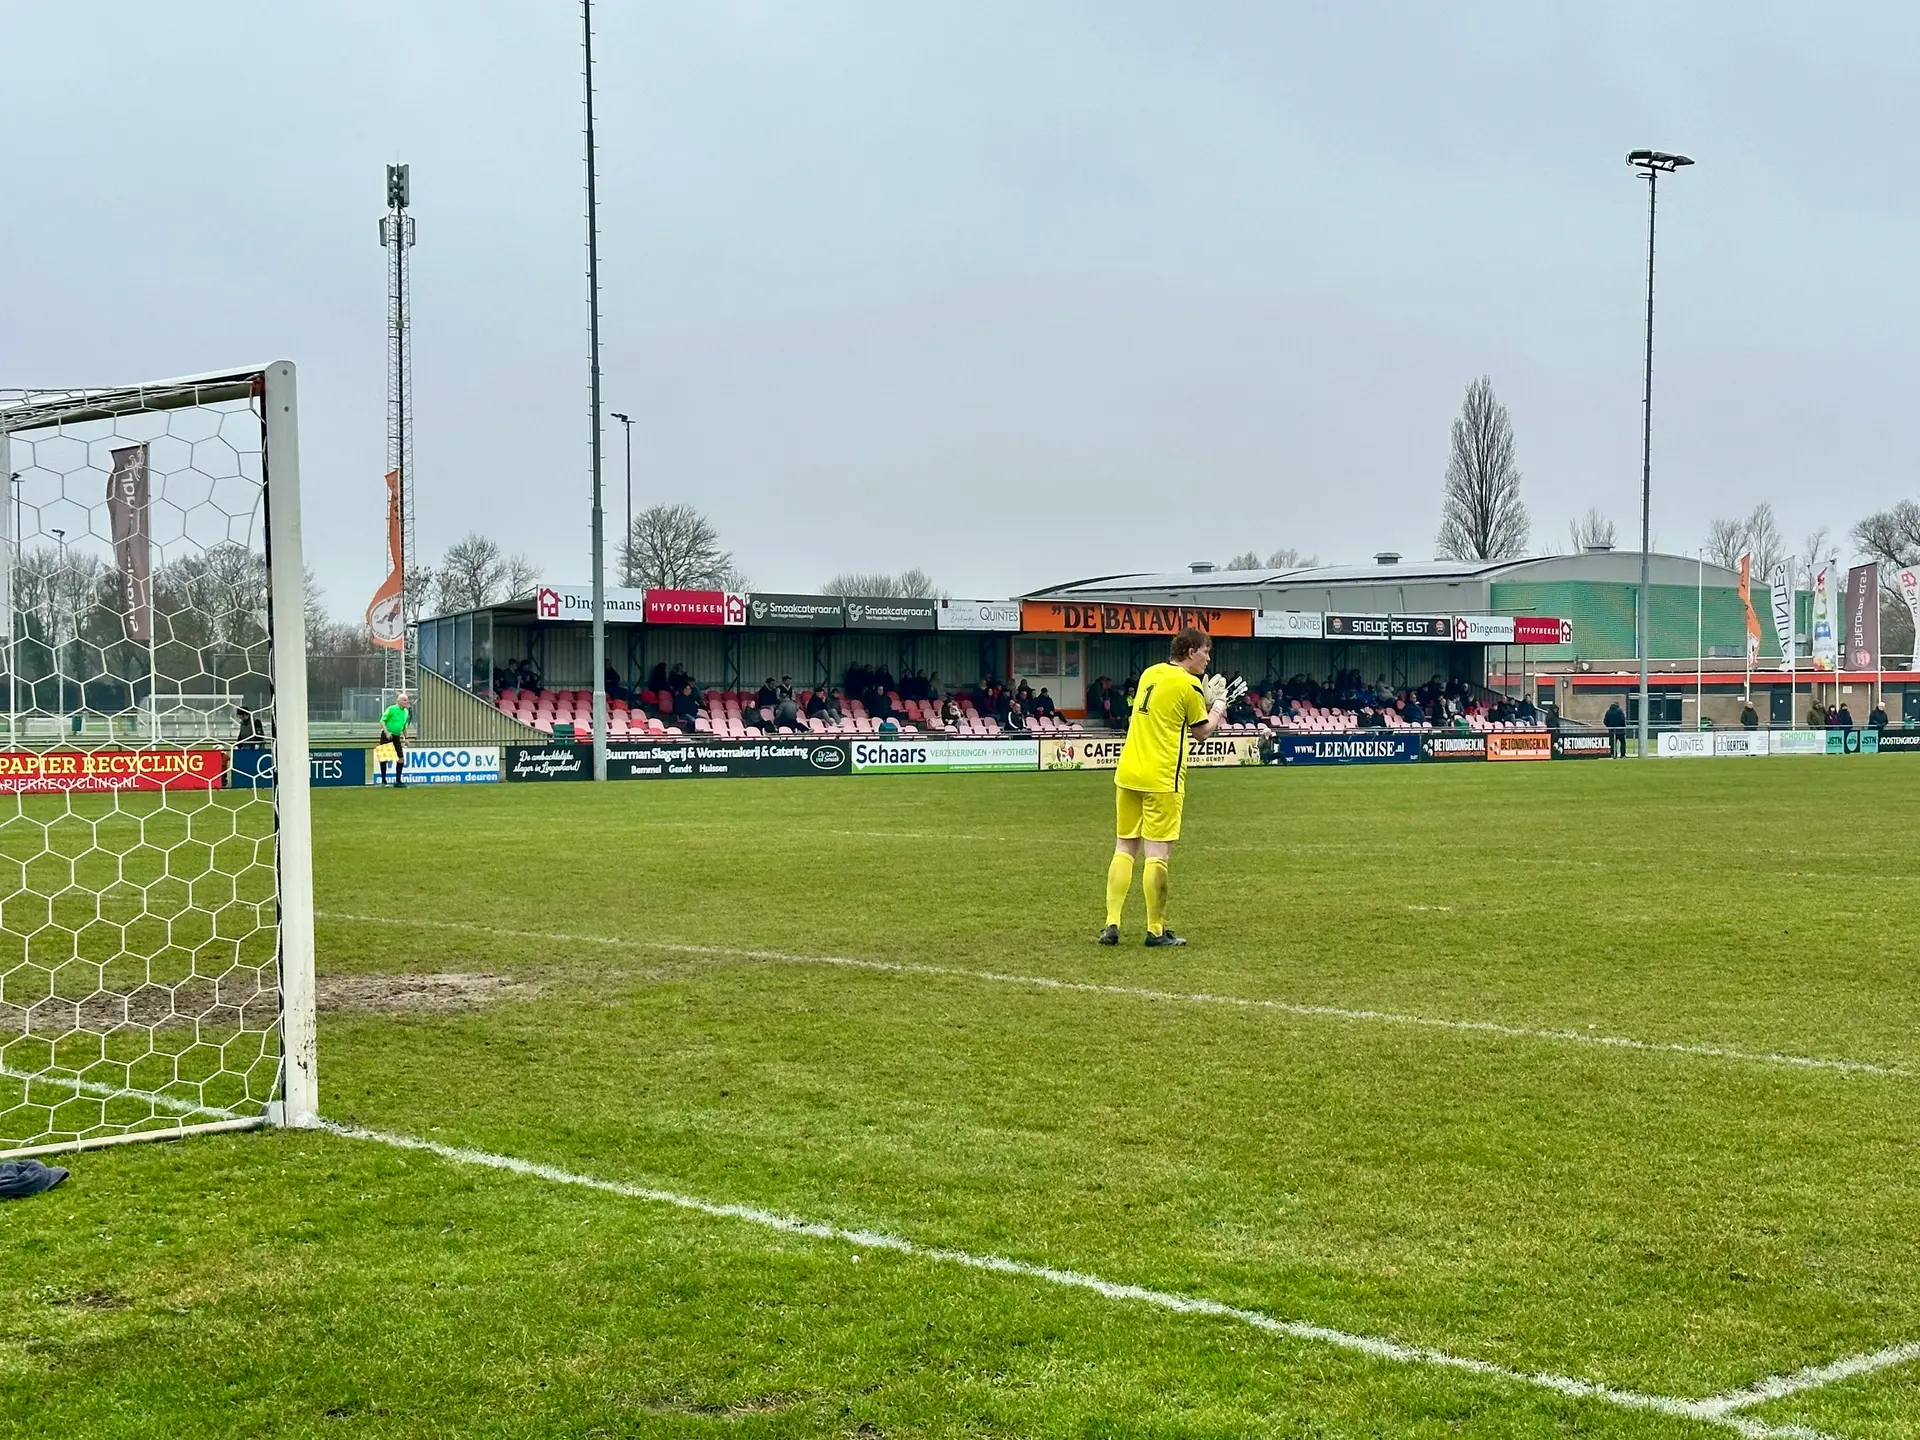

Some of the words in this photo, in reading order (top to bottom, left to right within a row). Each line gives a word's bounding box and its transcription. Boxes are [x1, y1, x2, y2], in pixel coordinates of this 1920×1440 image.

[564, 595, 641, 614] Dinmans
[652, 602, 723, 614] HYPOTHEKEN
[769, 602, 841, 614] Smaakcateraar.nl
[865, 604, 932, 616] Smaakcateraar.nl
[979, 606, 1019, 622] QUINTES
[1288, 616, 1321, 630] QUINTES
[1406, 621, 1429, 633] ELST
[1470, 622, 1514, 635] Dingemans
[1518, 627, 1560, 635] HYPOTHEKEN
[1138, 683, 1157, 715] 1
[1780, 732, 1816, 740] SCHOUTEN
[1827, 736, 1843, 745] JSTN
[1861, 736, 1877, 745] JSTN
[1188, 741, 1237, 756] ZZERIA
[1294, 741, 1405, 758] www.LEEMREISE.nl
[1434, 738, 1486, 751] BETONDINGEN.NL
[1563, 737, 1611, 750] BETONDINGEN.NL
[1668, 735, 1704, 752] QUINTES
[606, 749, 651, 760] Buurman
[652, 747, 687, 762] Slagerij
[687, 747, 696, 758] &
[696, 746, 760, 760] Worstmakerij
[761, 746, 769, 757] &
[770, 745, 809, 759] Catering
[856, 744, 926, 764] Schaars
[930, 749, 987, 758] VERZEKERINGEN
[992, 748, 1038, 757] HYPOTHEKEN
[82, 755, 204, 773] RECYCLING
[475, 755, 497, 767] B.V.
[631, 765, 662, 774] Bemmel
[669, 764, 693, 773] Gendt
[699, 763, 728, 774] Huissen
[430, 774, 461, 783] ramen
[465, 772, 498, 781] deuren
